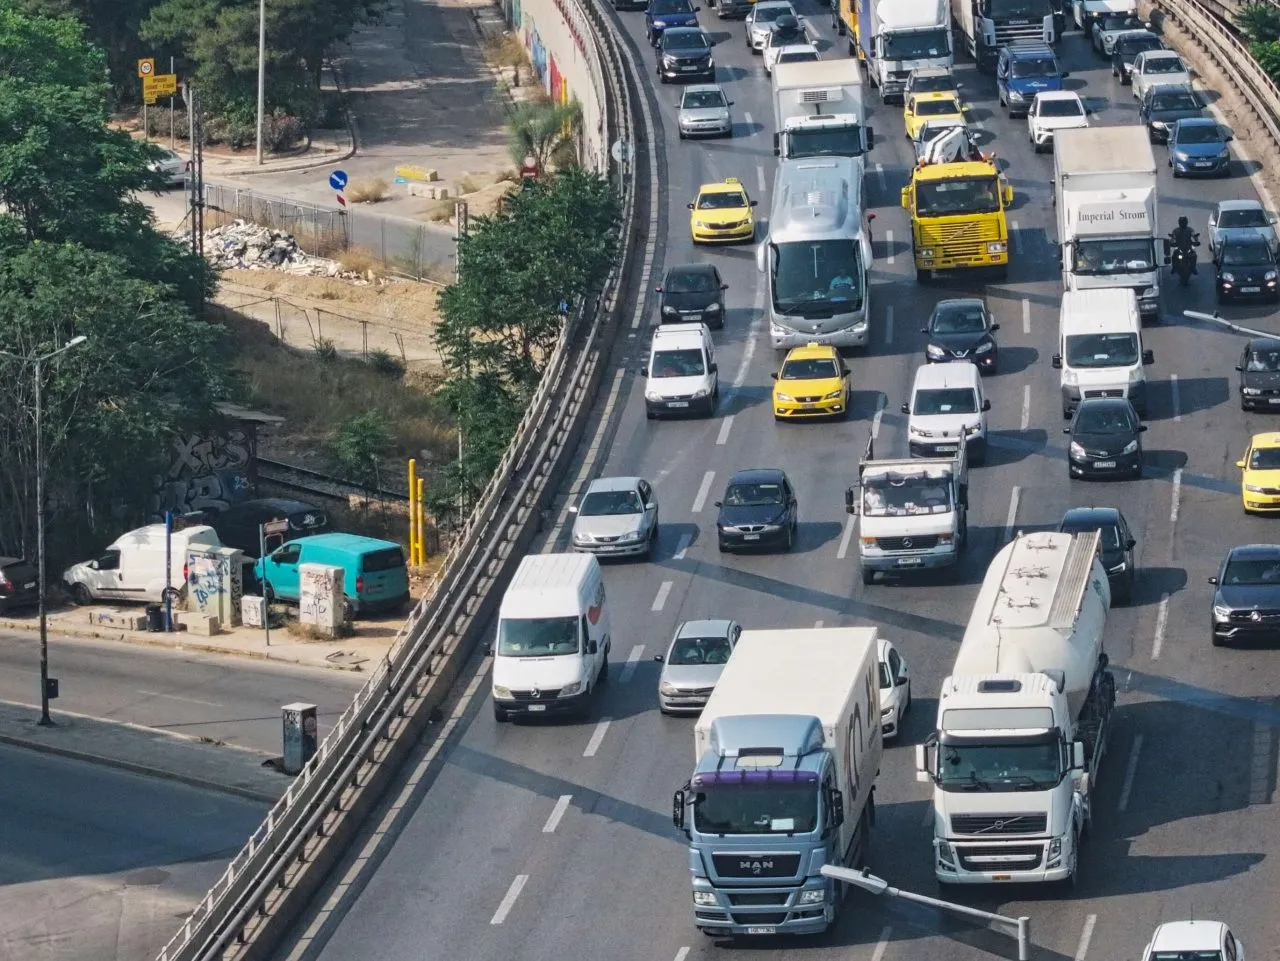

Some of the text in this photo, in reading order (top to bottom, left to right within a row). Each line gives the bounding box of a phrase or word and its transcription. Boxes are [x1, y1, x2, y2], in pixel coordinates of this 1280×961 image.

[1078, 209, 1145, 224] Imperial Strom
[740, 861, 773, 869] MAN
